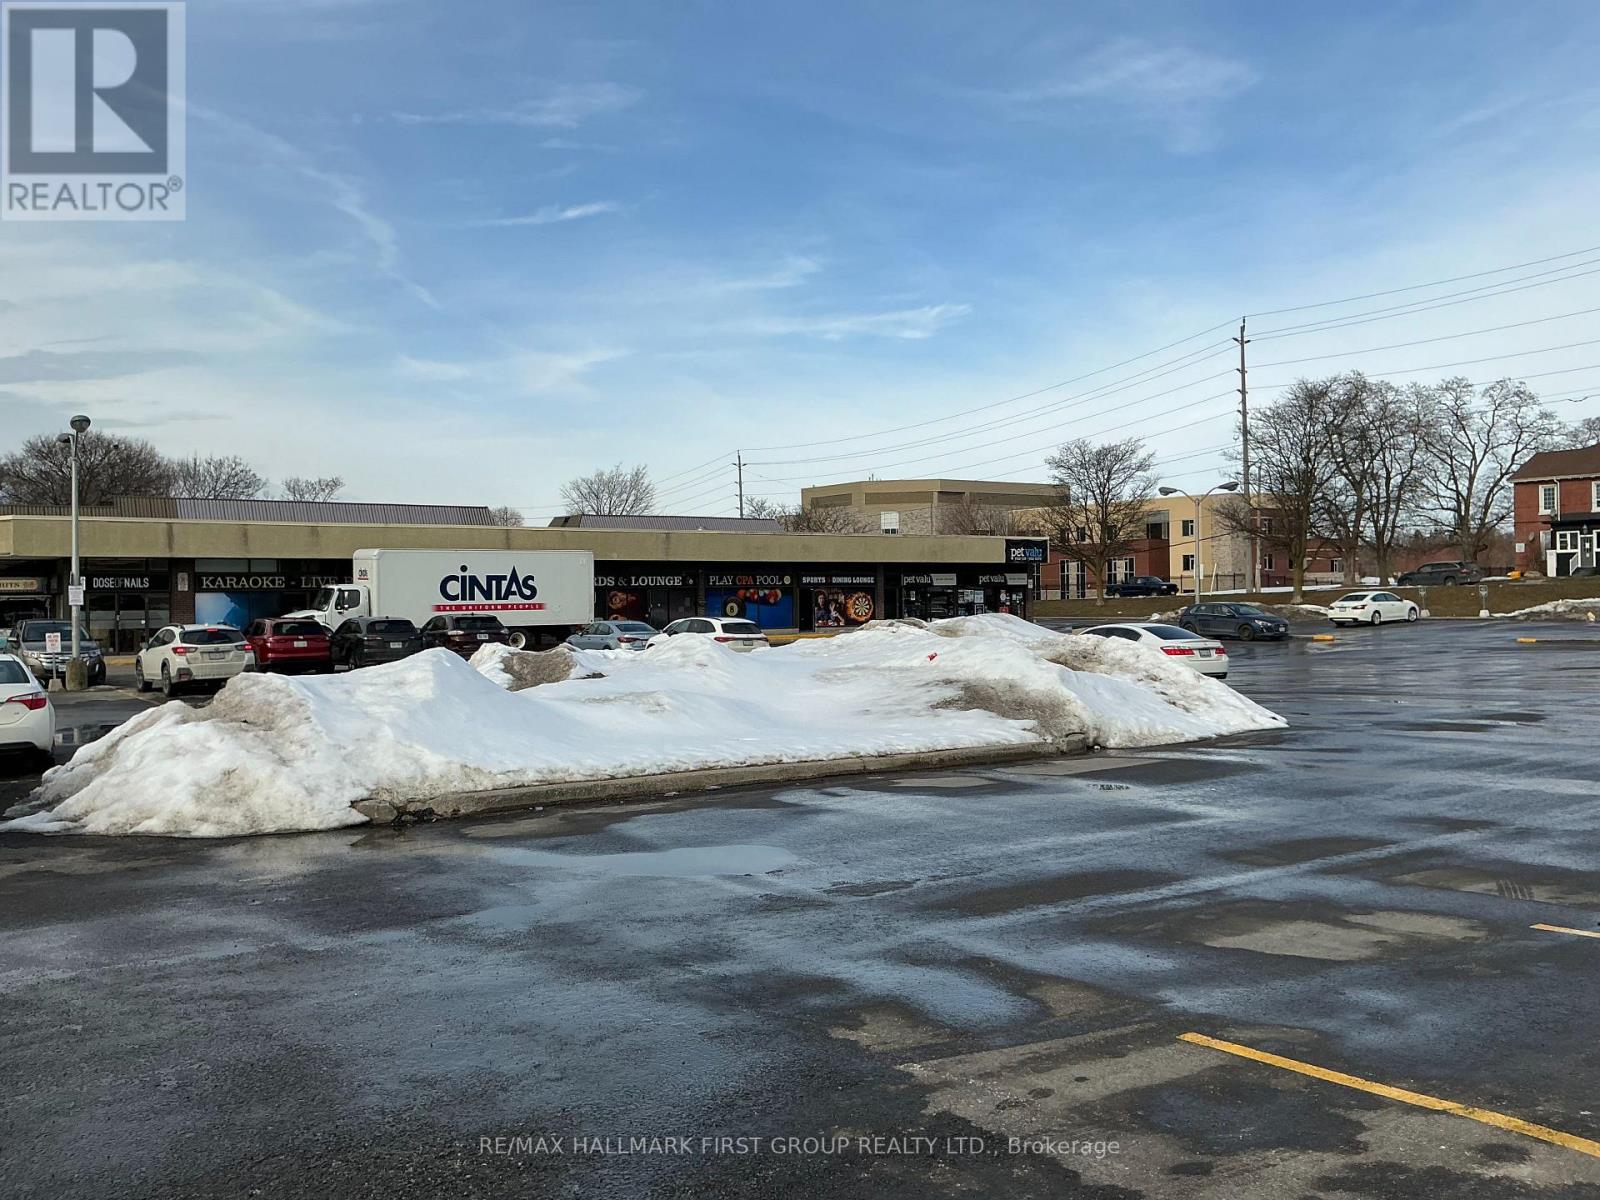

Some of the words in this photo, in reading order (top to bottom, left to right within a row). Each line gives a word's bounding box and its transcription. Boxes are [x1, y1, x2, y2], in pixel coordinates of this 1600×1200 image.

[1010, 547, 1024, 560] pet
[202, 576, 286, 589] KARAOKE
[301, 576, 338, 588] LIVE
[631, 576, 682, 586] LOUNGE
[709, 576, 733, 585] PLAY
[756, 576, 783, 585] POOL
[903, 575, 915, 585] pet
[915, 574, 931, 583] valu
[979, 574, 990, 584] pet
[990, 574, 1005, 583] valu
